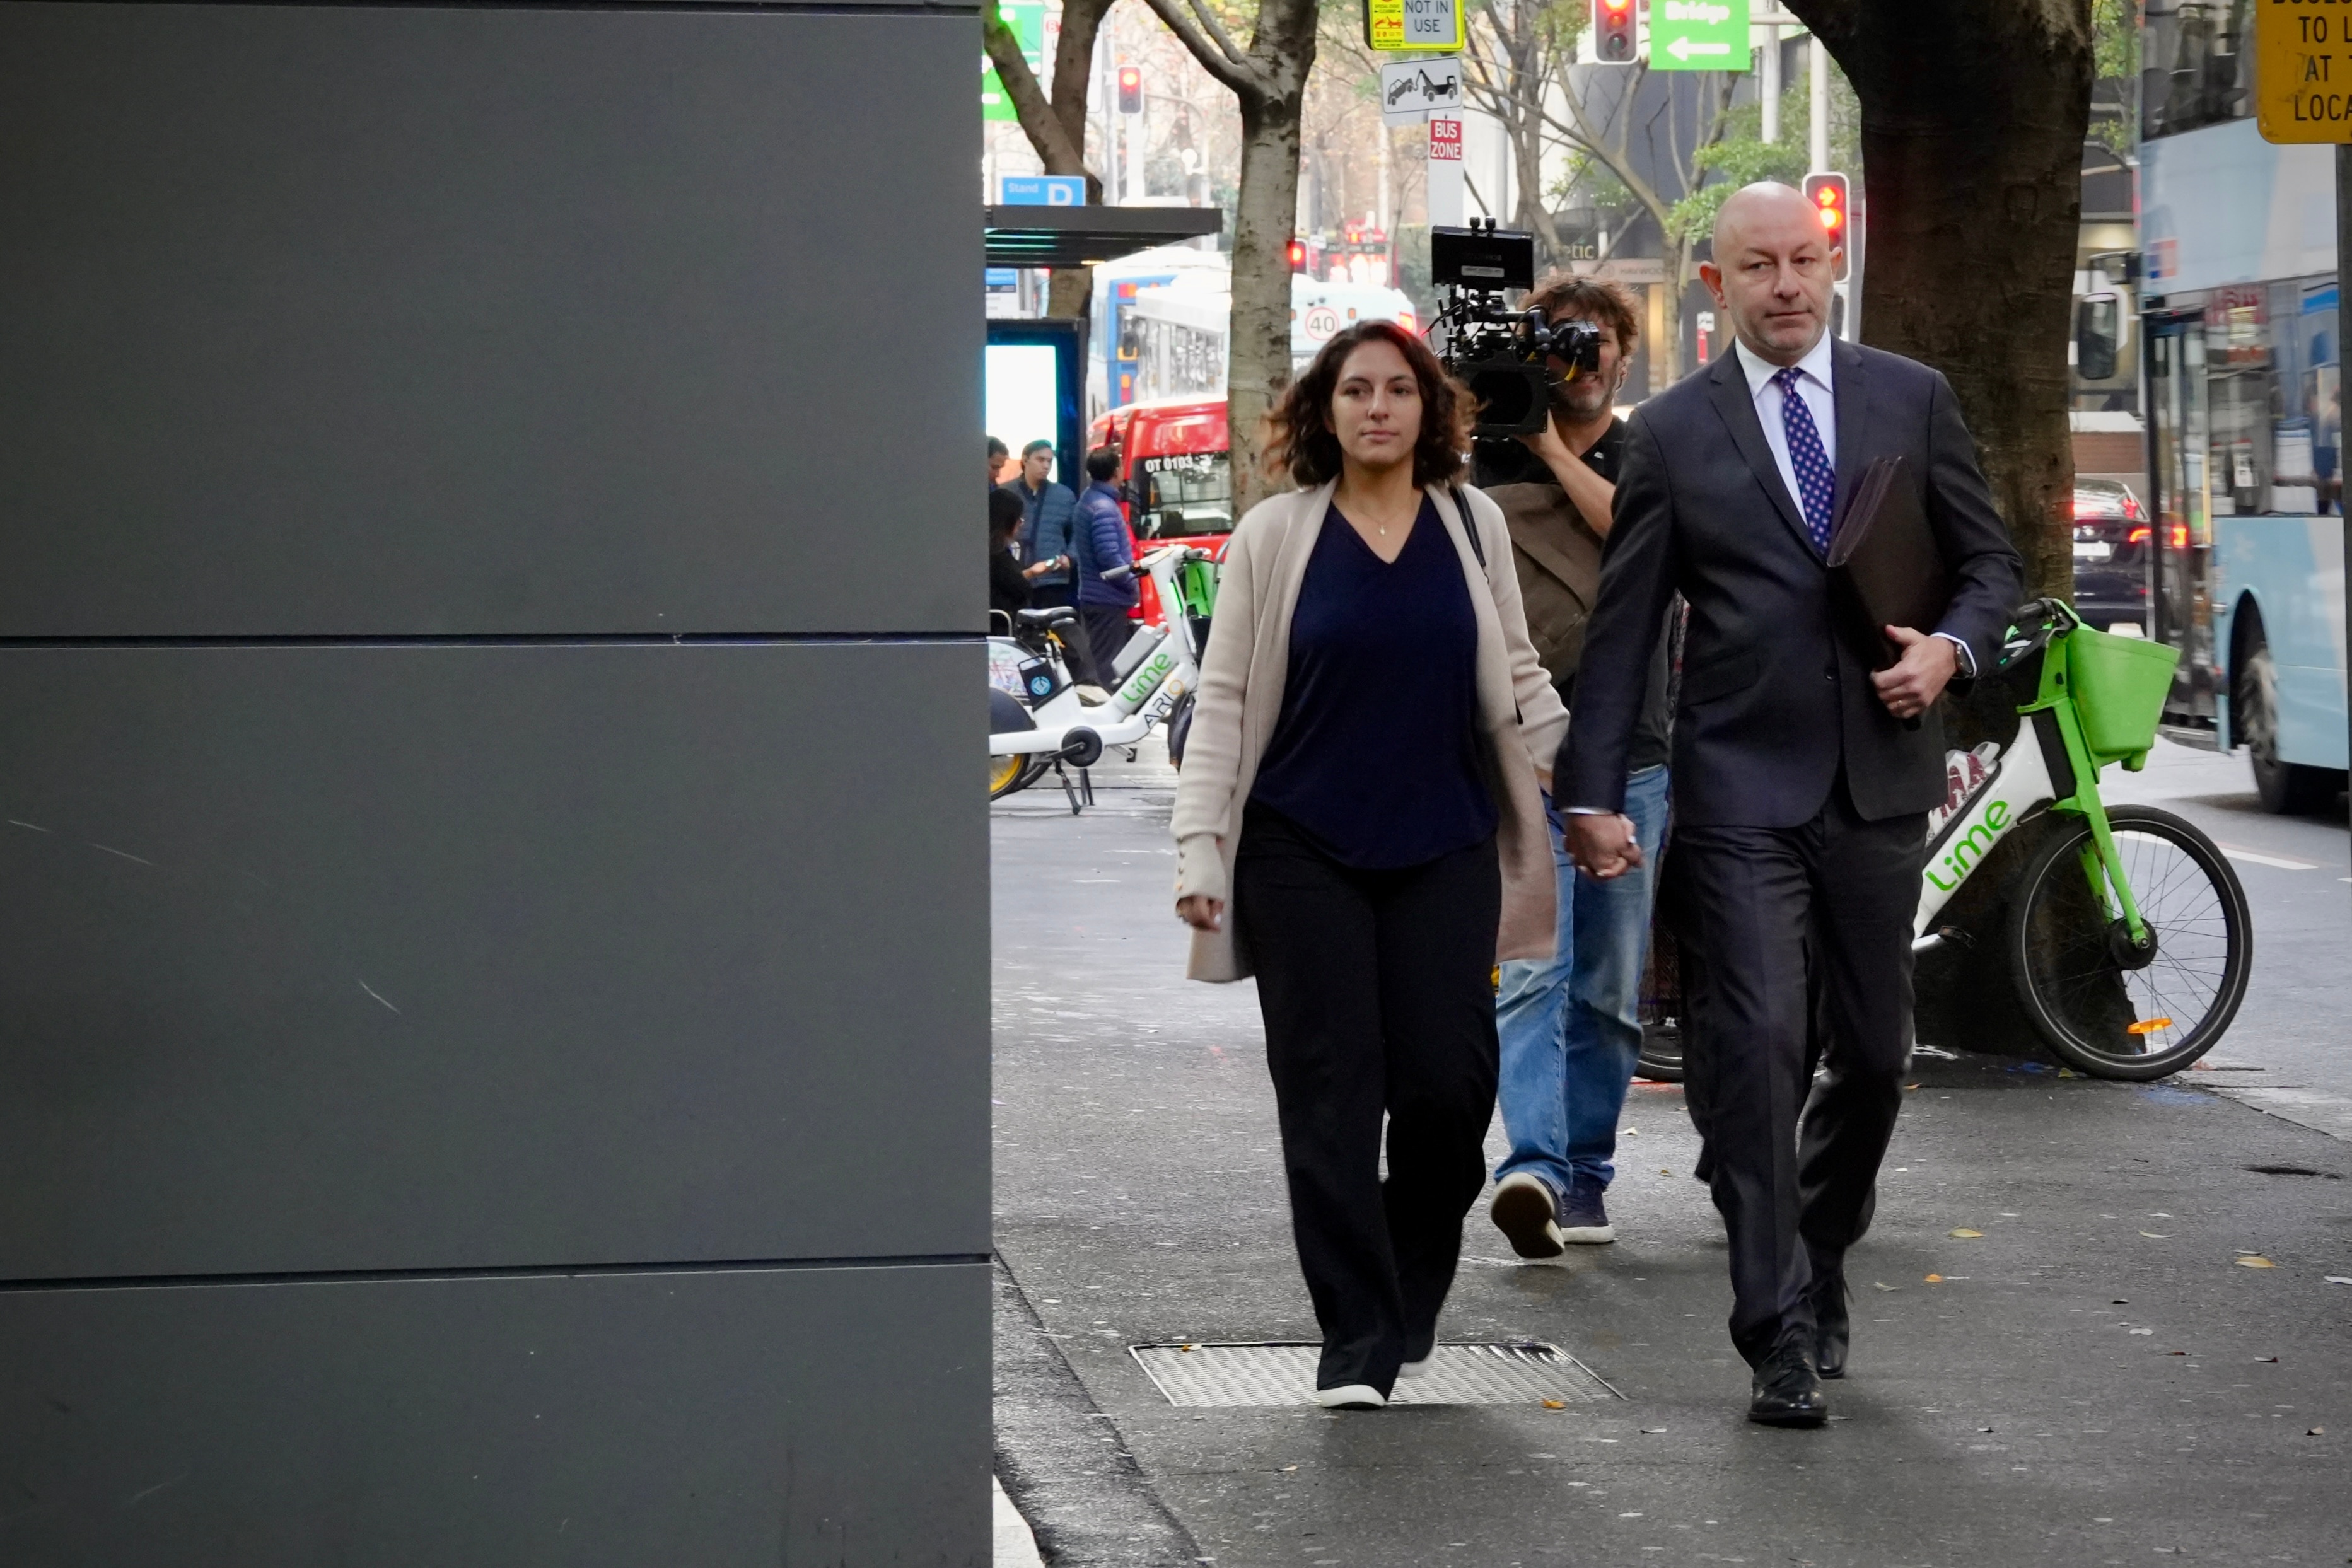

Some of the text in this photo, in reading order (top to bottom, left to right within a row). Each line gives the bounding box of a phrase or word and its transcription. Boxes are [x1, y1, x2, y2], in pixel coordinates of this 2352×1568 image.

[1406, 1, 1448, 13] NOT IN
[1665, 1, 1730, 25] Bridge
[1414, 19, 1440, 32] USE
[2298, 16, 2327, 43] TO
[2305, 55, 2332, 82] AT
[1435, 122, 1457, 139] BUS
[1431, 141, 1461, 158] ZONE
[1008, 183, 1073, 206] Stand D
[1310, 317, 1335, 332] 40
[1144, 679, 1184, 729] ARIO
